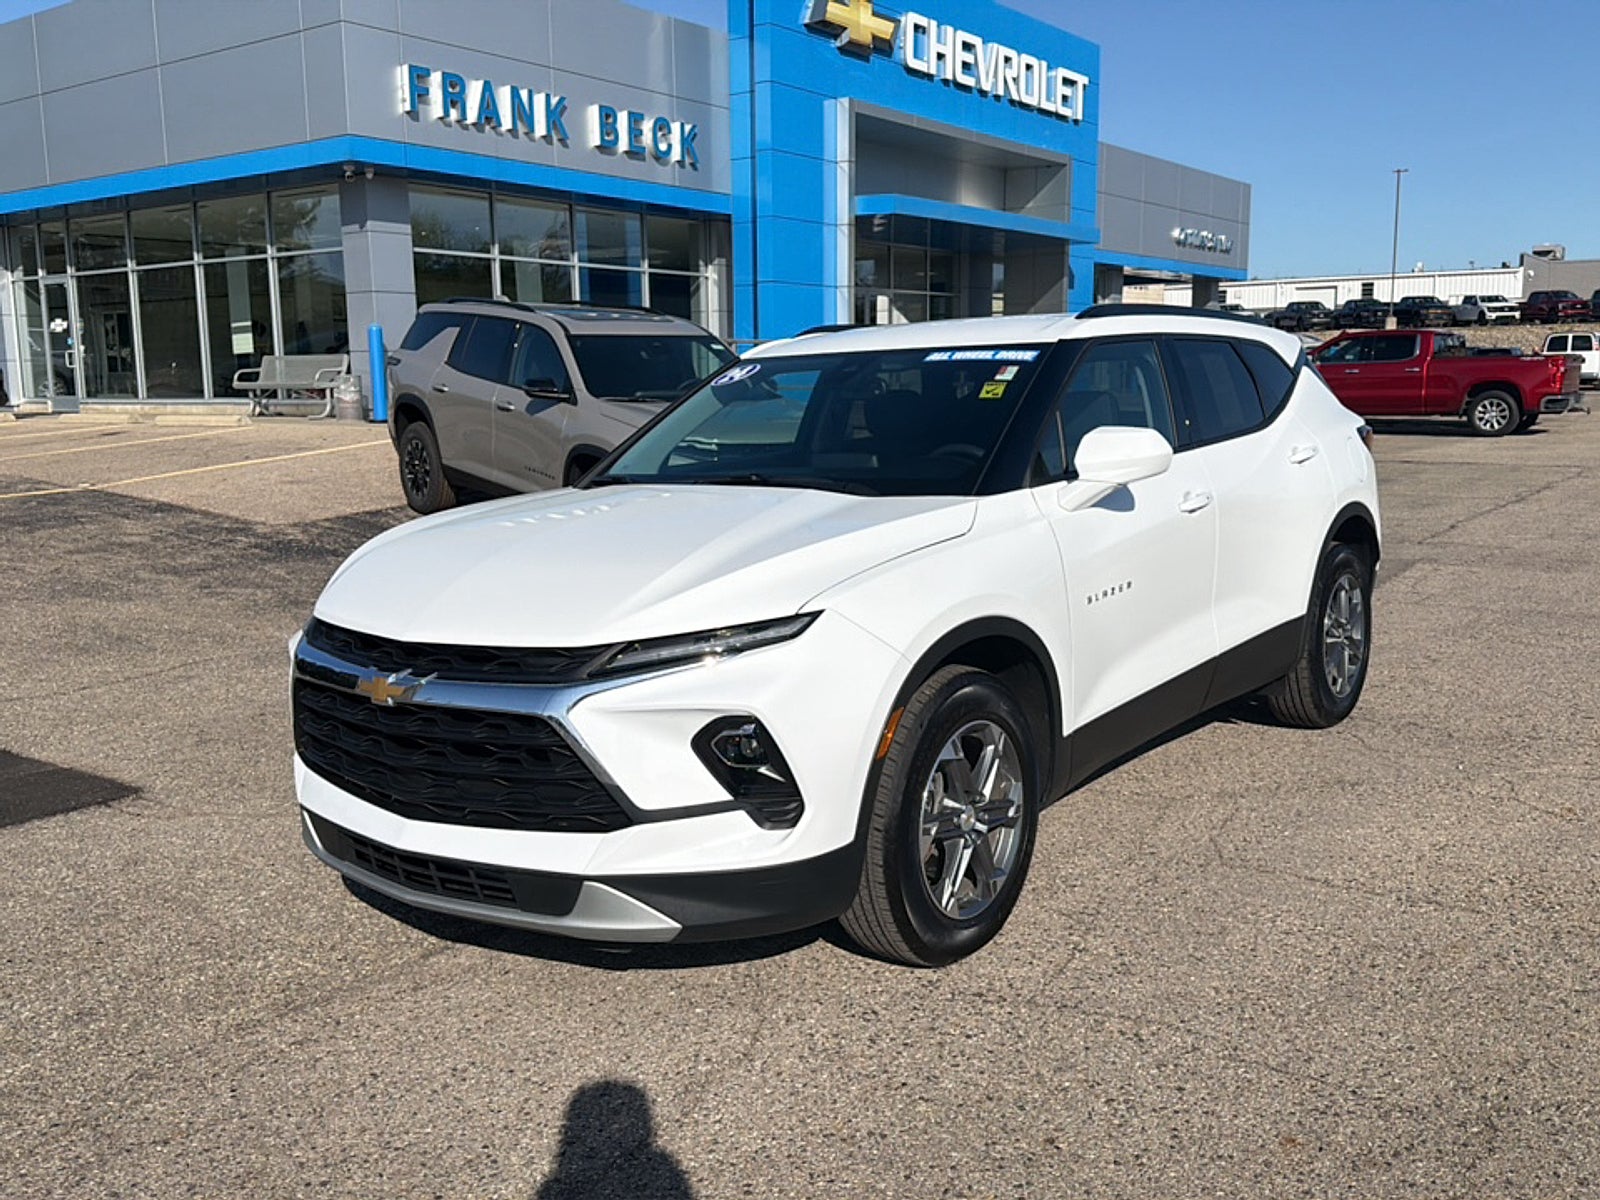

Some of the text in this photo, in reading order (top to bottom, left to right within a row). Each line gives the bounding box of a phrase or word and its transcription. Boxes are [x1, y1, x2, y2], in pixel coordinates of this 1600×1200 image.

[902, 11, 1090, 121] CHEVROLET
[401, 64, 699, 166] FRANK BECK
[924, 351, 952, 361] ALL
[951, 351, 996, 361] WHEEL
[1087, 580, 1132, 606] BLAZER
